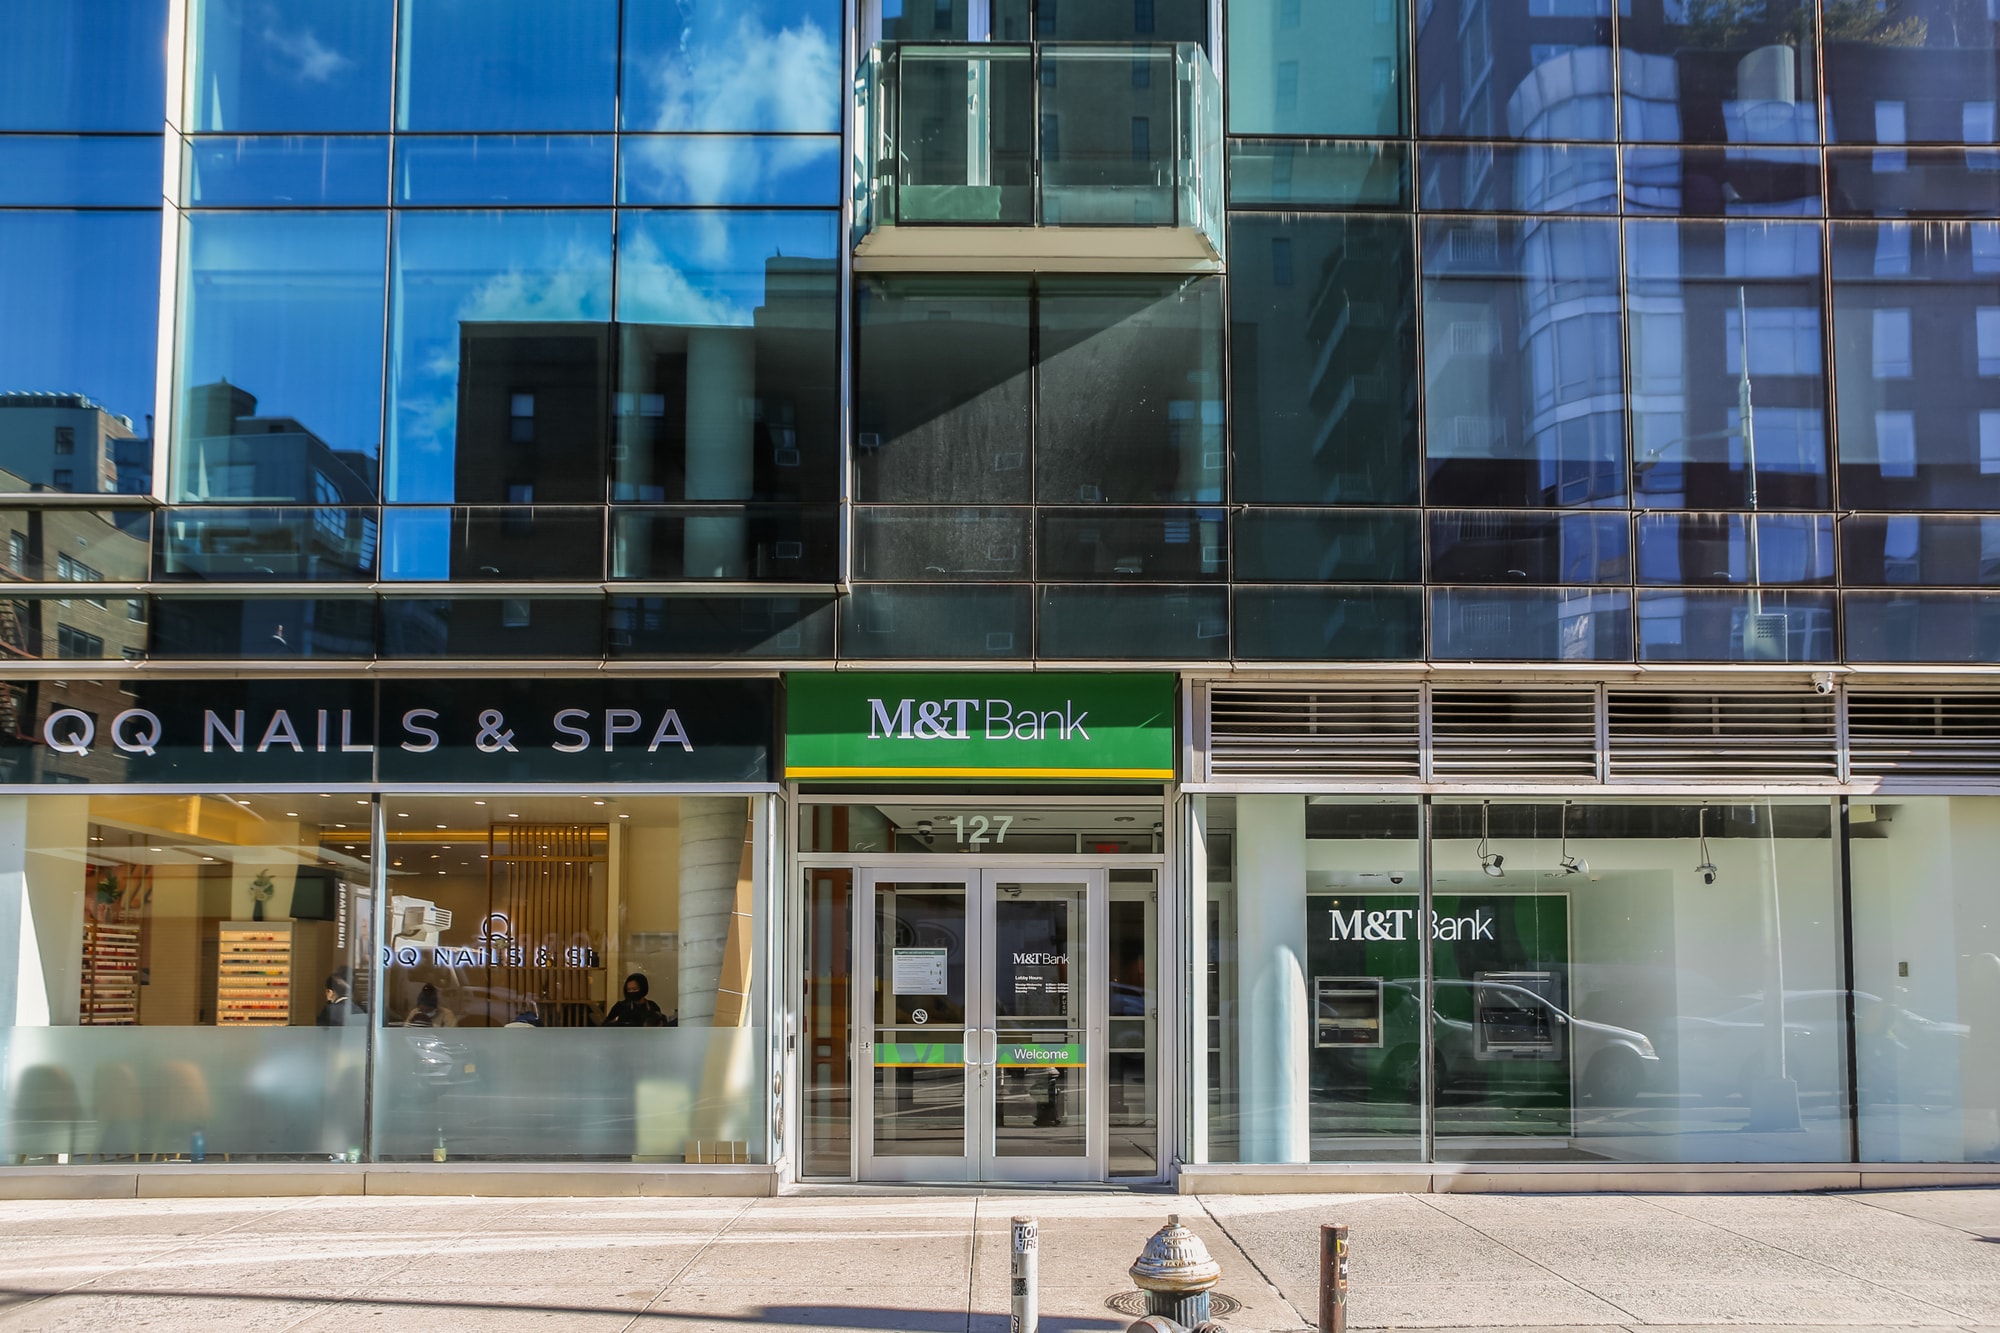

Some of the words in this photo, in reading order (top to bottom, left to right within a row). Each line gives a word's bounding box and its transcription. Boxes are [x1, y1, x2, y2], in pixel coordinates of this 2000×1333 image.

[43, 708, 162, 757] QQ
[203, 708, 440, 753] NAILS
[475, 708, 519, 753] &
[551, 708, 694, 753] SPA
[866, 698, 980, 740] M&T
[985, 698, 1091, 740] Bank
[950, 815, 1014, 844] 127
[1328, 909, 1413, 941] M&T
[1417, 908, 1494, 941] Bank
[1013, 953, 1042, 964] M&T
[1042, 953, 1070, 965] Bank
[1014, 1048, 1069, 1060] Welcome
